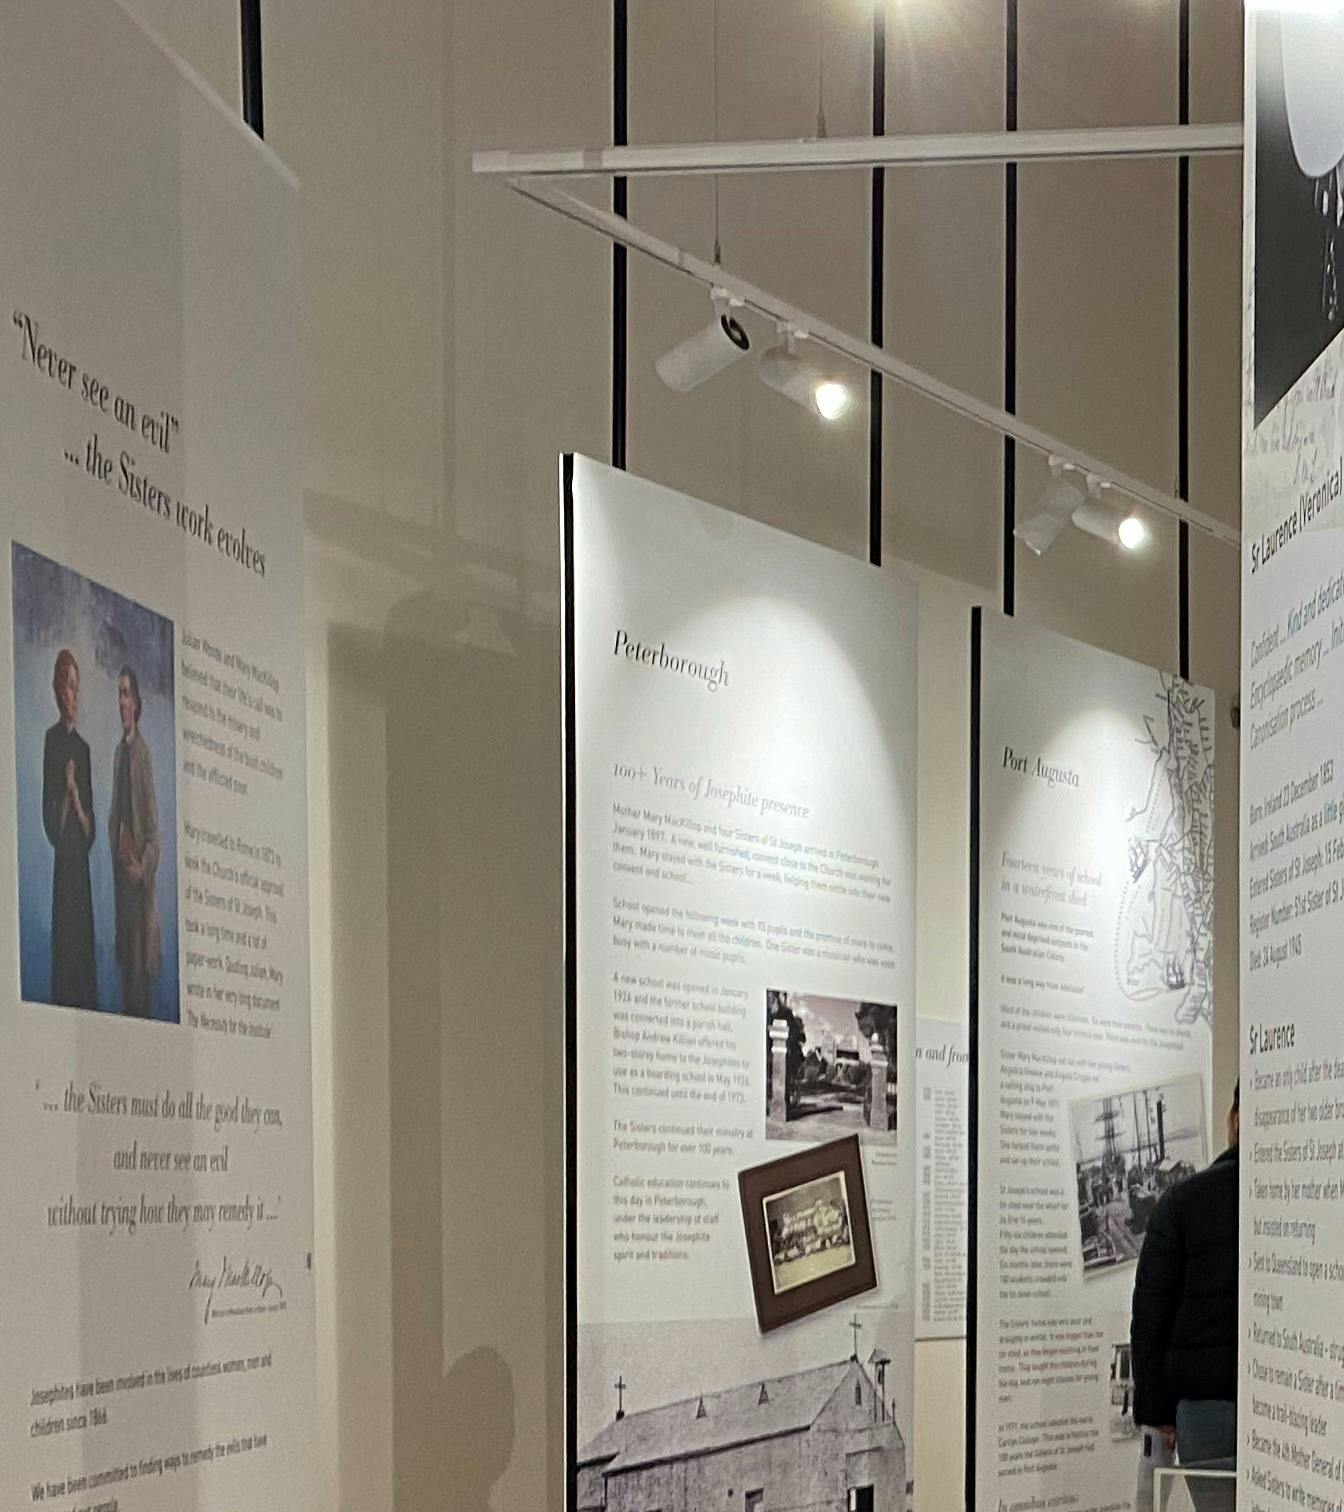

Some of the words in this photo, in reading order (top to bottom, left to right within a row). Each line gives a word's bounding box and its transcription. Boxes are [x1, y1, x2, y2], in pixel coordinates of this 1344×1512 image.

[80, 372, 110, 413] see
[113, 395, 137, 432] an
[85, 433, 114, 484] the
[118, 450, 171, 520] Sisters
[176, 500, 214, 546] work
[216, 527, 266, 577] evolves
[1251, 542, 1261, 575] Sr
[1261, 510, 1298, 566] Laurence
[1299, 455, 1343, 533] (Veronica)
[1250, 623, 1280, 671] Confident
[1287, 600, 1304, 639] Kind
[1302, 588, 1317, 627] and
[613, 630, 729, 692] Peterborough
[1249, 654, 1294, 711] Encyclopaedic
[1293, 638, 1323, 678] memory
[1249, 704, 1289, 751] Canonisation
[1288, 688, 1317, 732] process
[613, 763, 647, 782] 100+
[653, 765, 686, 791] Years
[688, 776, 704, 801] of
[703, 777, 759, 809] Josephite
[759, 797, 810, 819] presence
[1002, 745, 1028, 773] Port
[1030, 751, 1080, 789] Augusta
[1263, 787, 1283, 818] Ireland
[1290, 770, 1319, 804] December
[1319, 758, 1334, 787] 1853
[1269, 825, 1287, 854] South
[1284, 812, 1311, 845] Australia
[1310, 812, 1318, 833] as
[1318, 810, 1323, 829] a
[1323, 798, 1338, 826] little
[1249, 870, 1269, 901] Entered
[1269, 866, 1288, 891] Sisters
[1287, 857, 1295, 883] of
[1294, 856, 1301, 880] St
[1324, 839, 1332, 865] 15
[1249, 910, 1271, 940] Register
[1307, 889, 1325, 913] Sister
[1324, 883, 1334, 908] of
[1331, 880, 1339, 904] St
[1269, 939, 1289, 970] August
[1288, 933, 1302, 957] 1945
[925, 1044, 946, 1062] and
[1249, 1024, 1259, 1056] Sr
[1259, 1023, 1296, 1054] Laurence
[63, 1080, 86, 1114] the
[86, 1080, 128, 1116] Sisters
[130, 1093, 160, 1118] must
[161, 1088, 176, 1119] do
[178, 1090, 194, 1120] all
[194, 1091, 214, 1122] the
[213, 1095, 240, 1134] good
[240, 1096, 262, 1134] they
[112, 1139, 138, 1171] and
[139, 1150, 172, 1172] never
[173, 1151, 192, 1173] see
[192, 1153, 208, 1173] an
[209, 1144, 230, 1173] evil
[47, 1193, 97, 1227] without
[100, 1196, 138, 1236] trying
[139, 1192, 165, 1225] how
[166, 1192, 192, 1233] they
[192, 1203, 217, 1233] may
[218, 1193, 255, 1231] remedy
[256, 1196, 264, 1221] it
